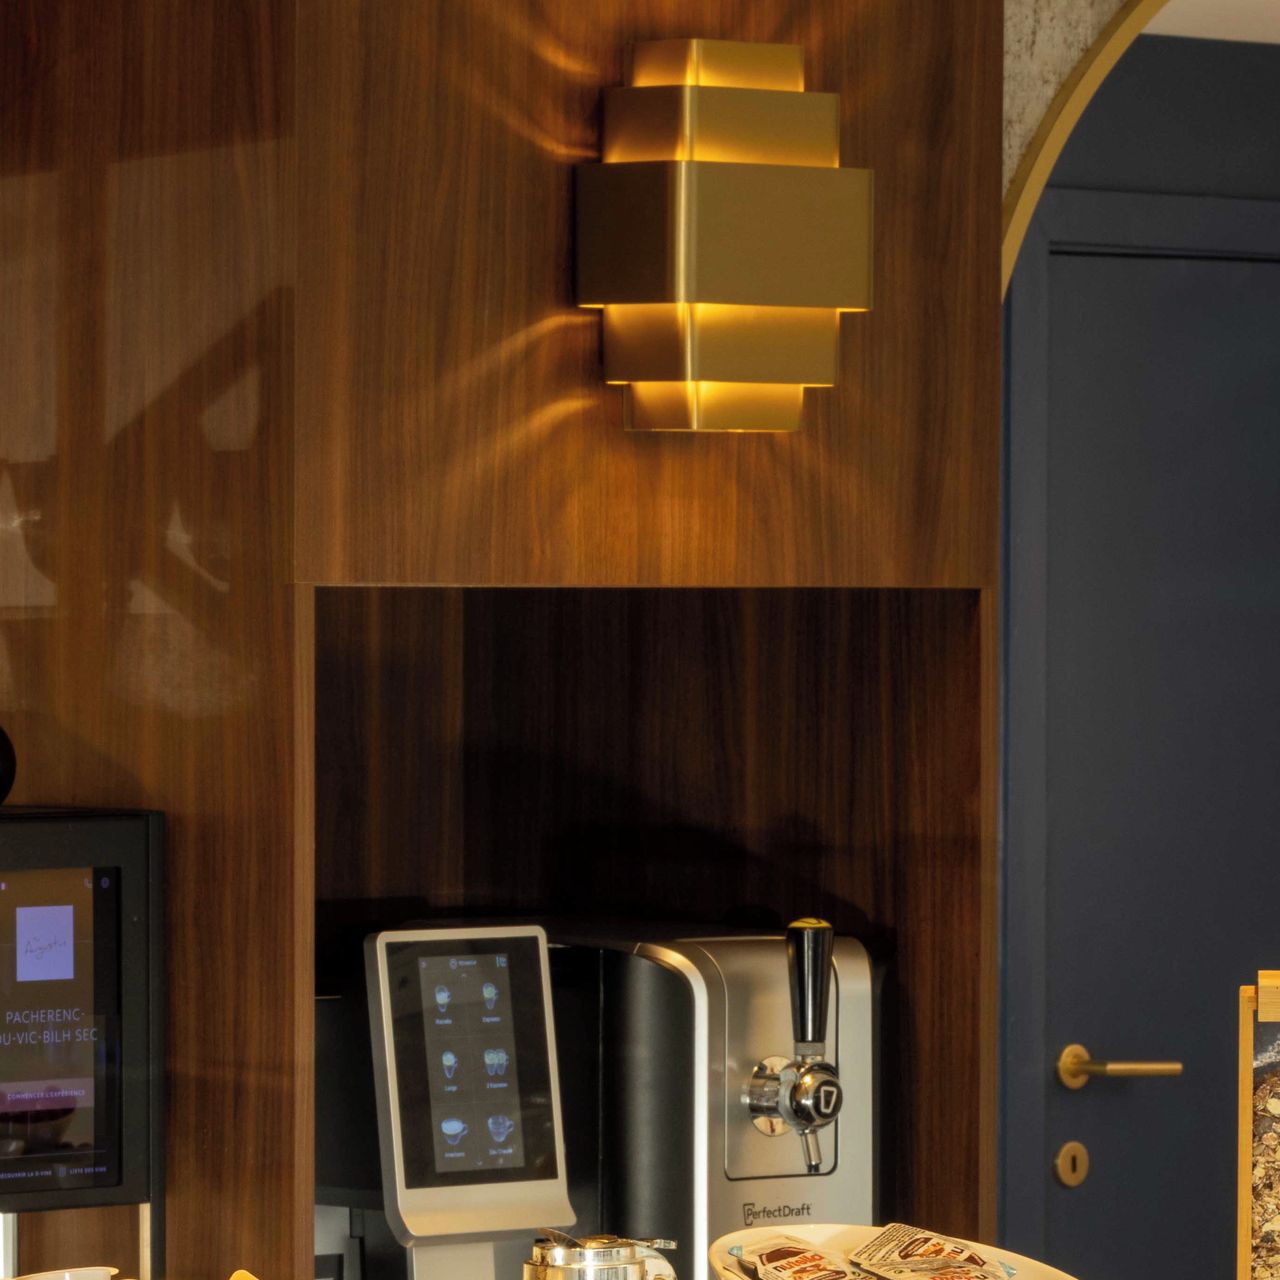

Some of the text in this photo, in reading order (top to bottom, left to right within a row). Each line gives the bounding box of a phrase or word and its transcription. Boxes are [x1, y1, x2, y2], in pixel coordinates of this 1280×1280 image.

[75, 1028, 98, 1041] SEC
[746, 1203, 811, 1220] PerfectDraft
[773, 1253, 825, 1273] nutella
